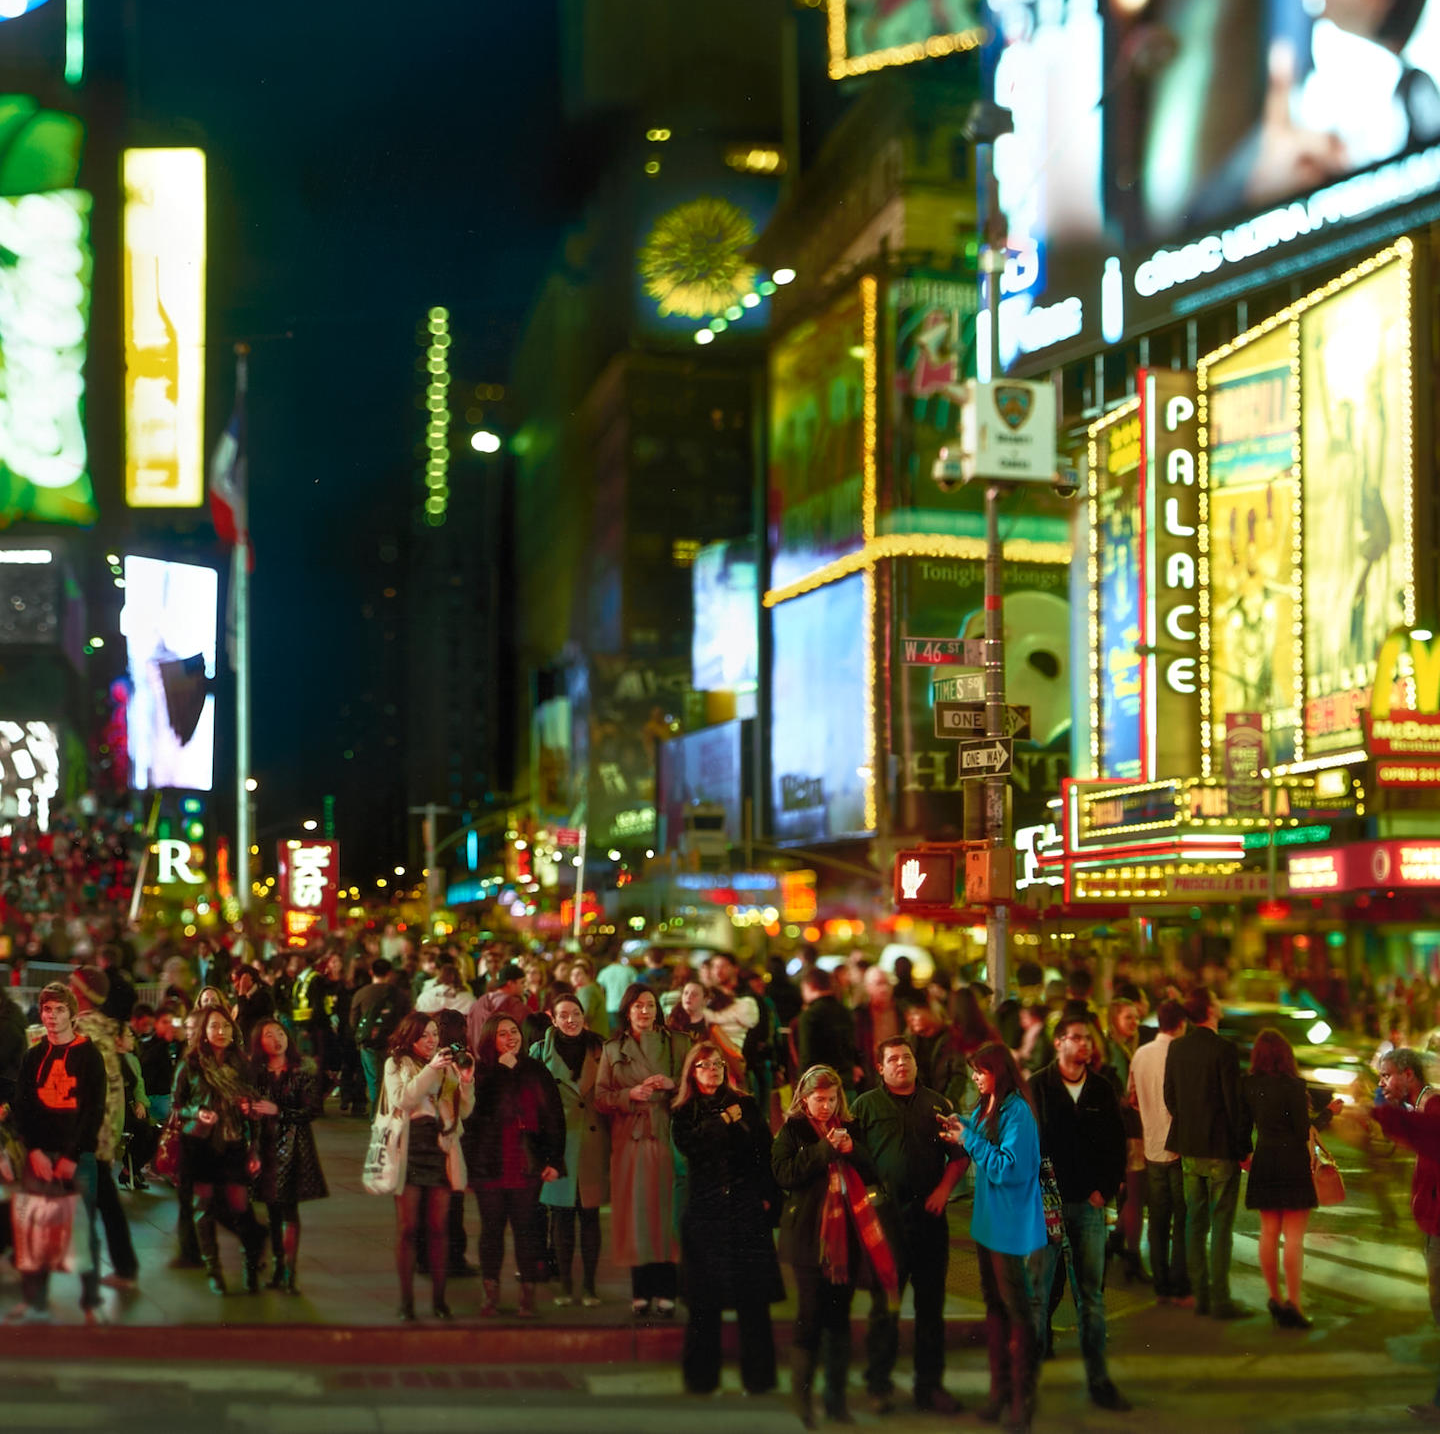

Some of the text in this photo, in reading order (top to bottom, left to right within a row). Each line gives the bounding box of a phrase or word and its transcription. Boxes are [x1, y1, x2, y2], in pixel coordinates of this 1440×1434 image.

[1166, 394, 1196, 694] PALACE
[905, 642, 960, 662] W 46 ST
[934, 678, 963, 702] TIMES
[952, 713, 981, 727] ONE
[966, 749, 1004, 766] ONE WAY
[156, 840, 206, 884] R
[291, 846, 331, 909] tkts
